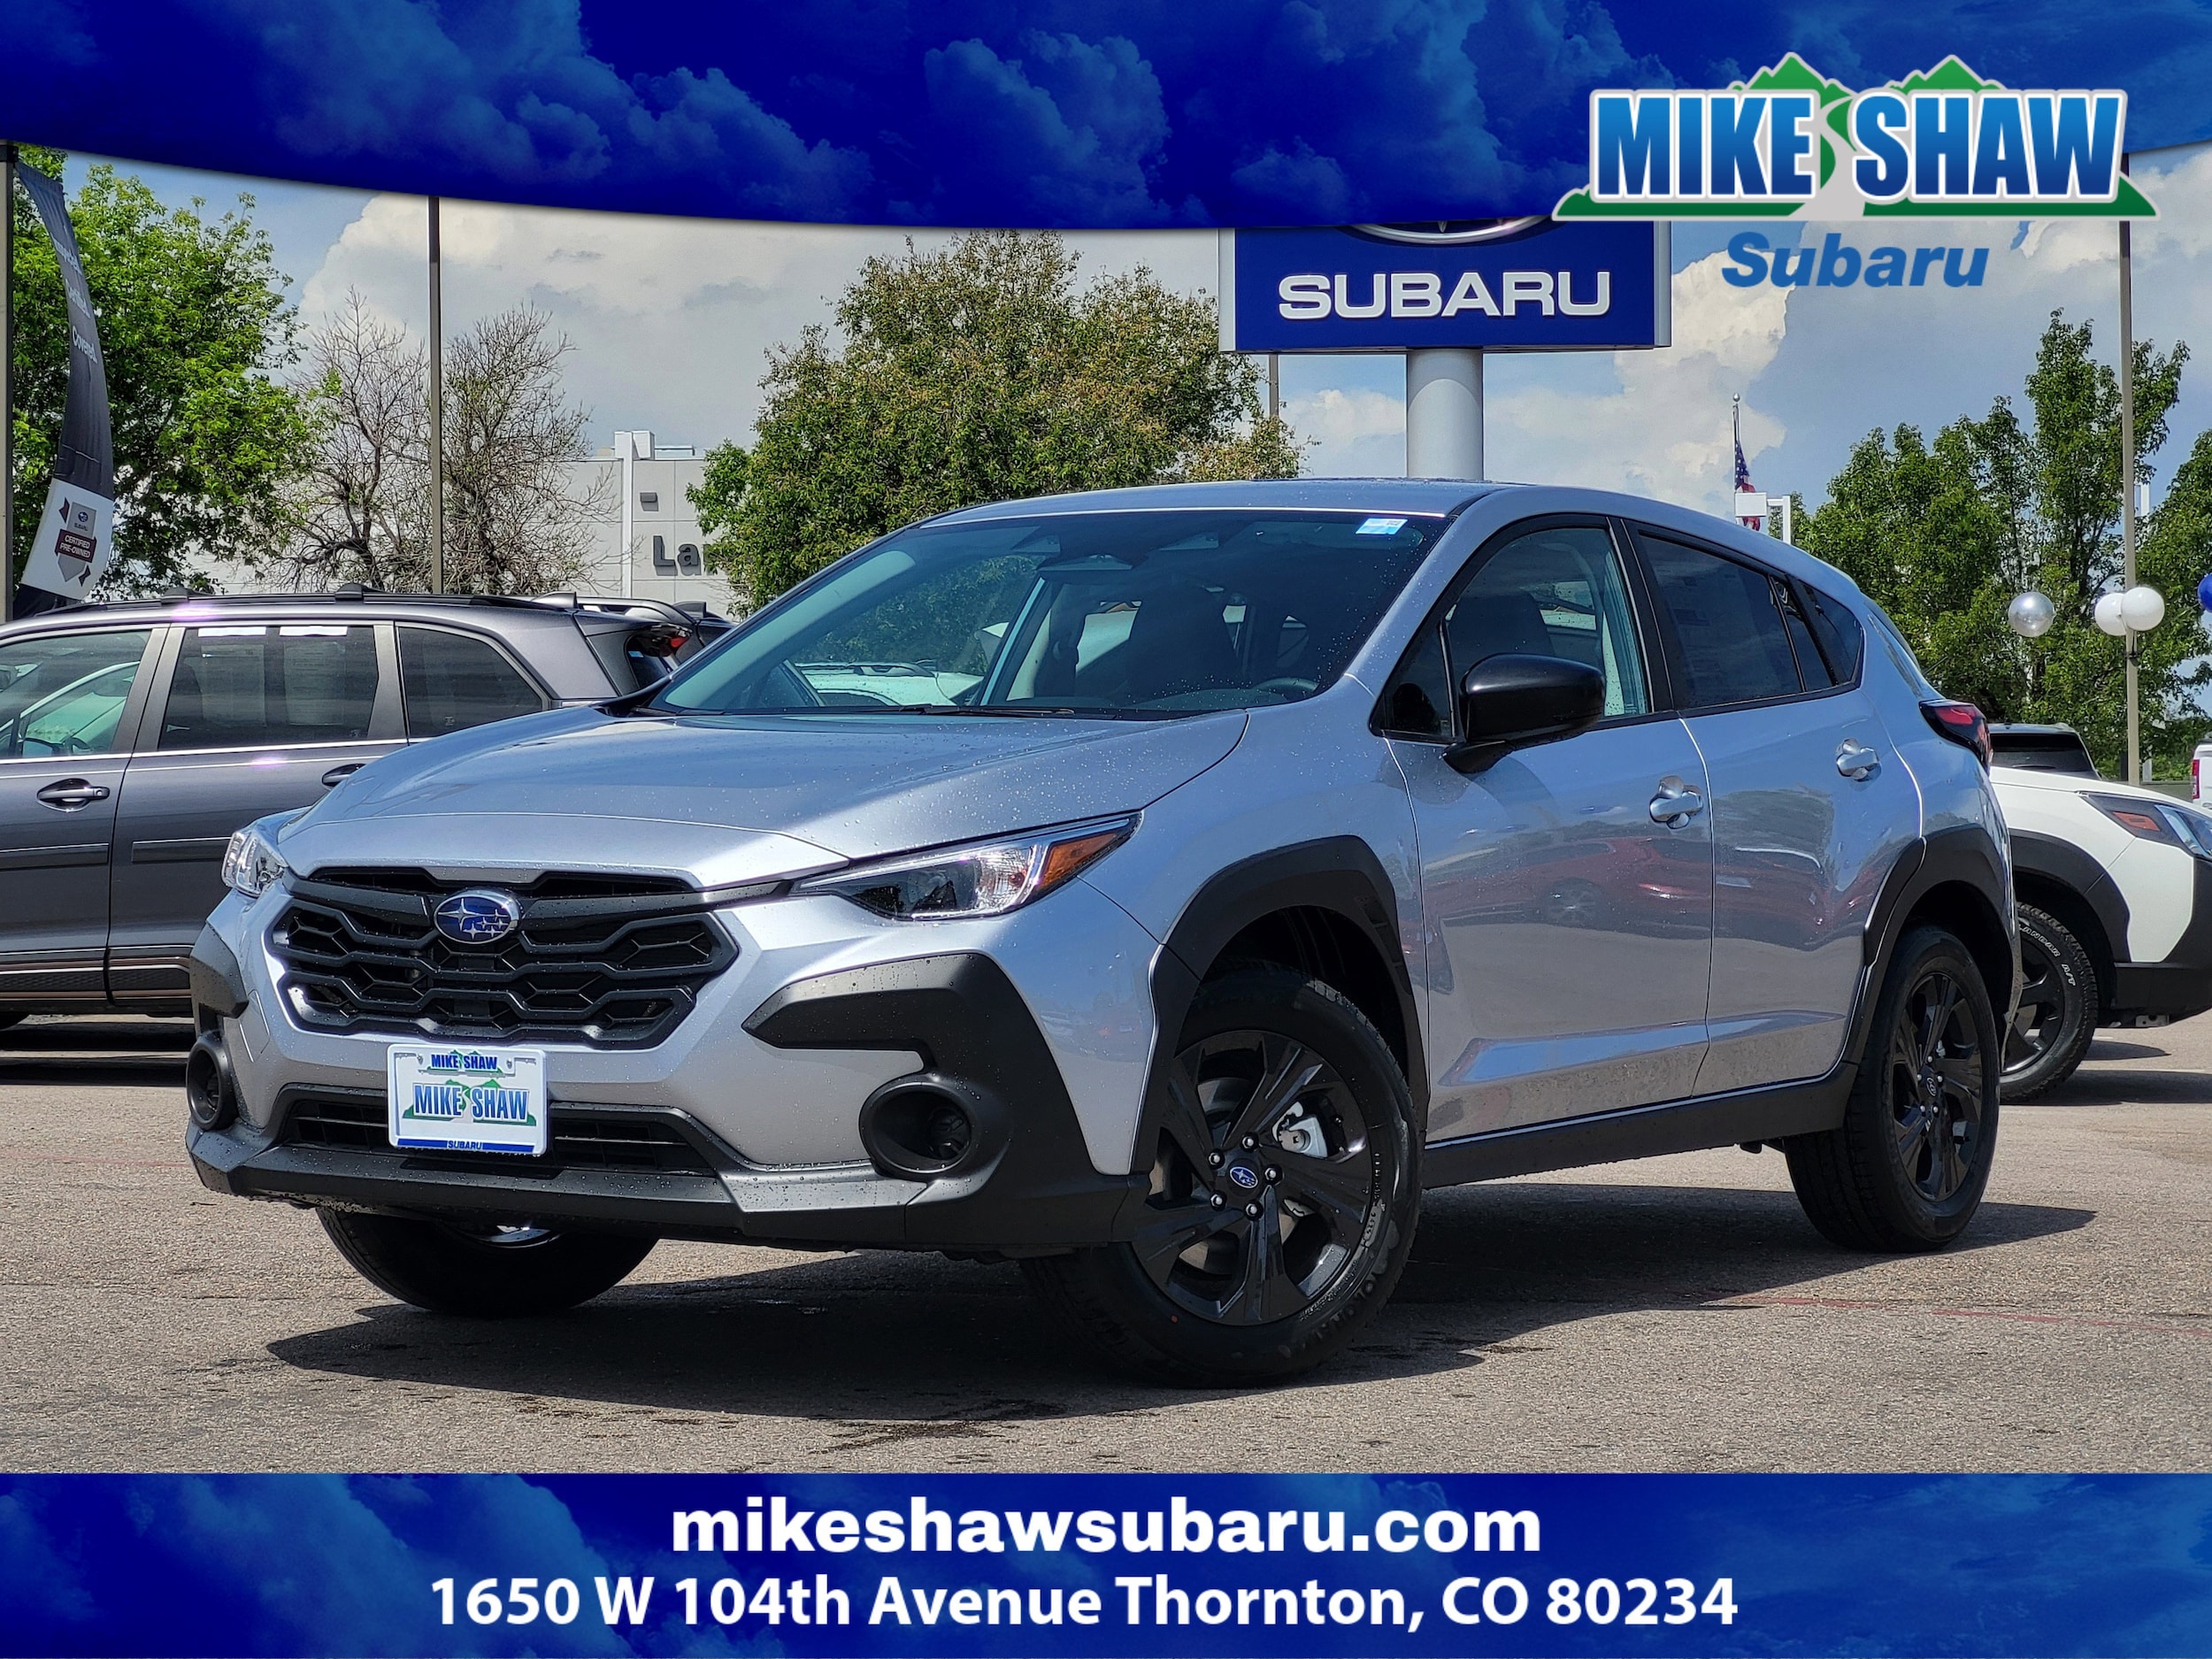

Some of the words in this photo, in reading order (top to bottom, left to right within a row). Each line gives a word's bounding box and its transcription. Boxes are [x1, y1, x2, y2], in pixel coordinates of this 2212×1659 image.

[1278, 270, 1611, 321] SUBARU
[59, 541, 91, 558] PRE-OWNED
[65, 534, 91, 549] CERTIFIED
[653, 535, 713, 567] La
[431, 1053, 459, 1069] MIKE
[463, 1056, 498, 1071] SHAW
[413, 1085, 463, 1117] MIKE
[470, 1087, 530, 1121] SHAW
[448, 1140, 482, 1150] SUBARU
